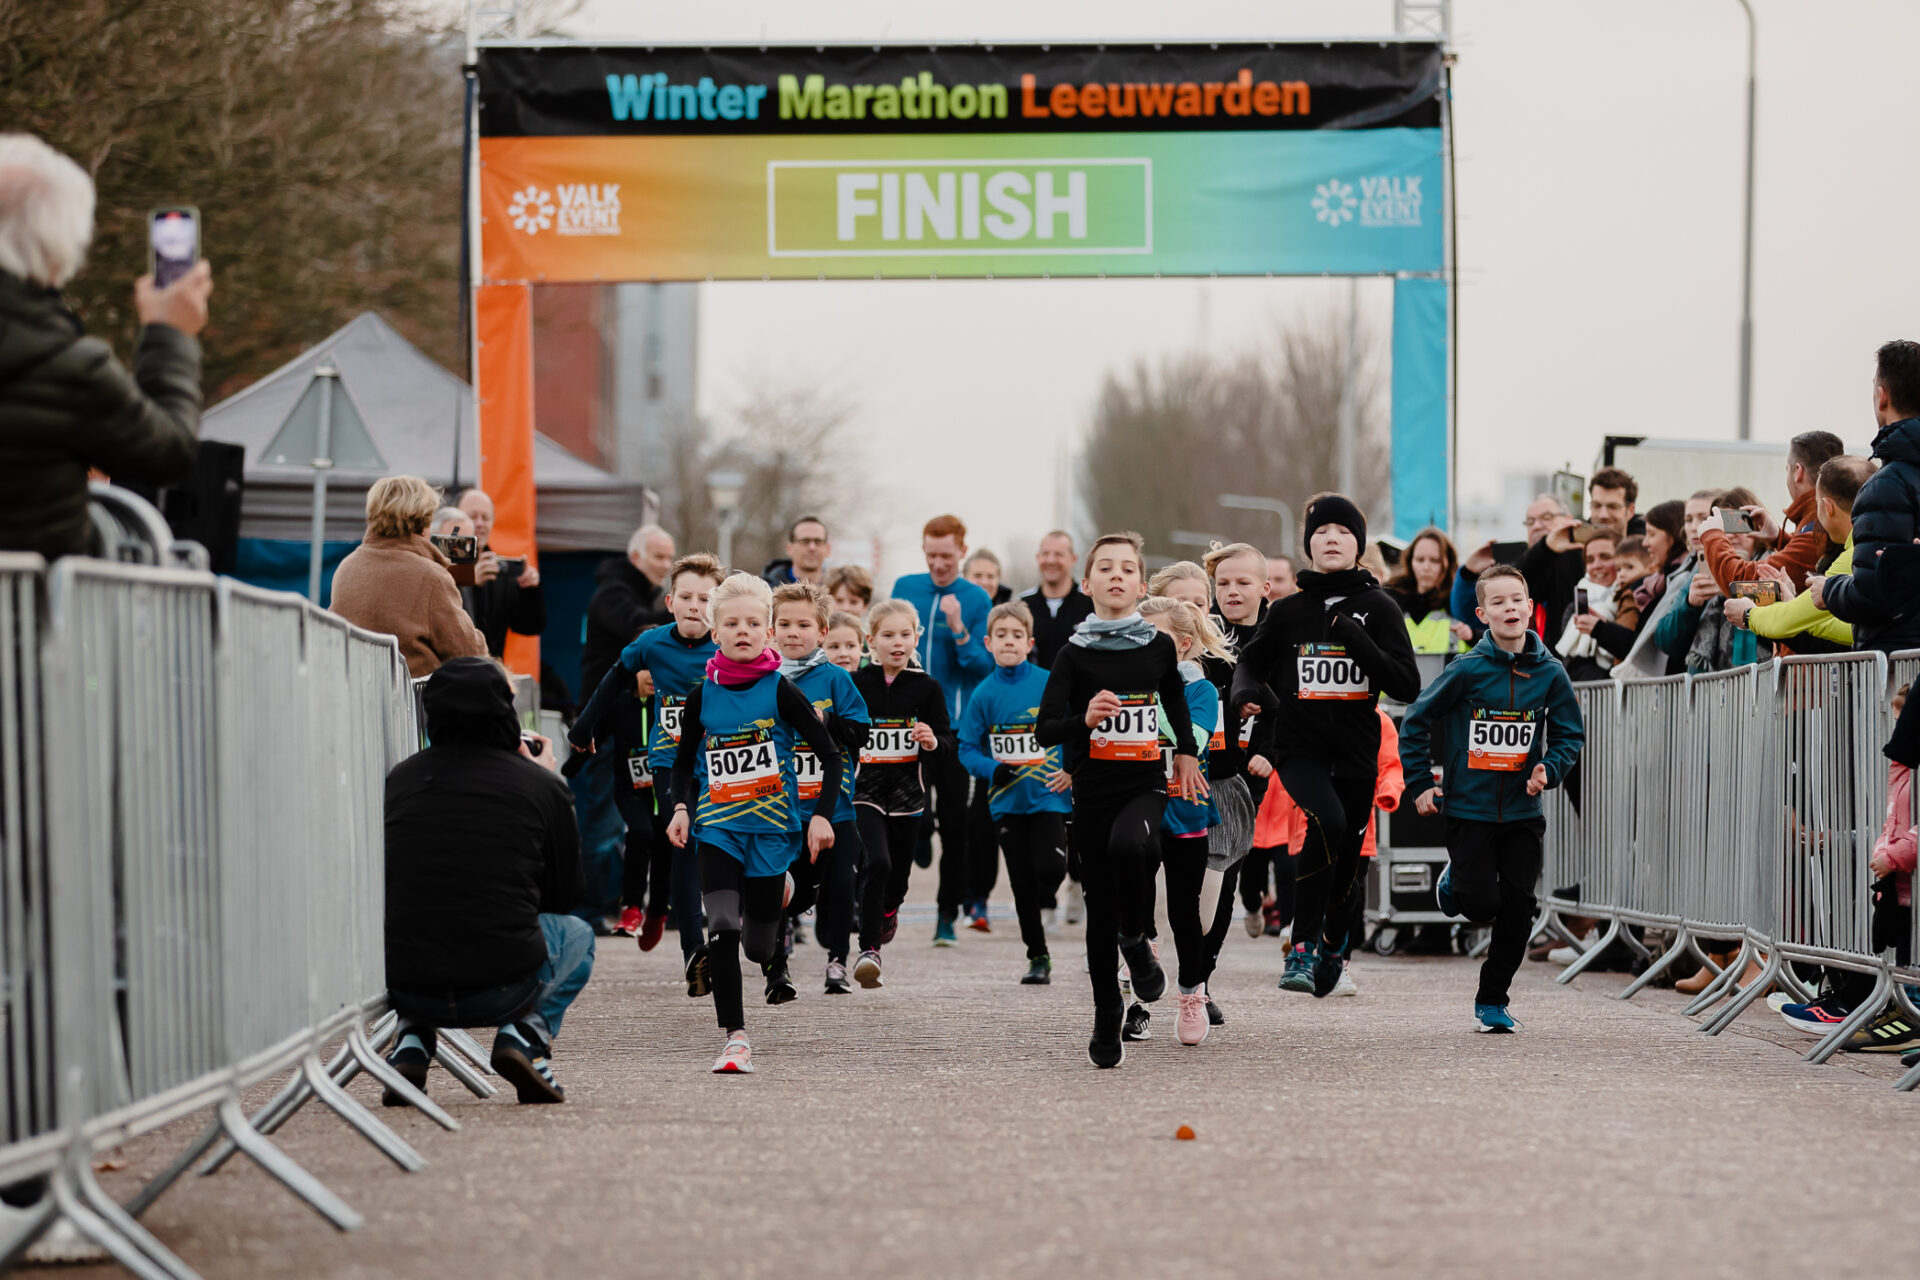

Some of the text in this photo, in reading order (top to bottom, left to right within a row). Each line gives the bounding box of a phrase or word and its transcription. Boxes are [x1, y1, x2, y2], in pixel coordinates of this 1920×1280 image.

[606, 68, 1311, 121] Winter Marathon Leeuwarden
[557, 184, 621, 207] VALK
[1360, 176, 1422, 200] VALK
[837, 171, 1087, 240] FINISH
[1360, 200, 1422, 218] EVENT
[558, 208, 621, 227] EVENT
[1302, 660, 1366, 685] 5000
[1097, 708, 1157, 734] 5013
[864, 730, 916, 751] 5019
[994, 736, 1040, 754] 5018
[1209, 740, 1220, 748] 30
[1474, 723, 1531, 747] 5006
[631, 759, 653, 777] 50
[711, 745, 772, 776] 5024
[755, 784, 777, 795] 5024
